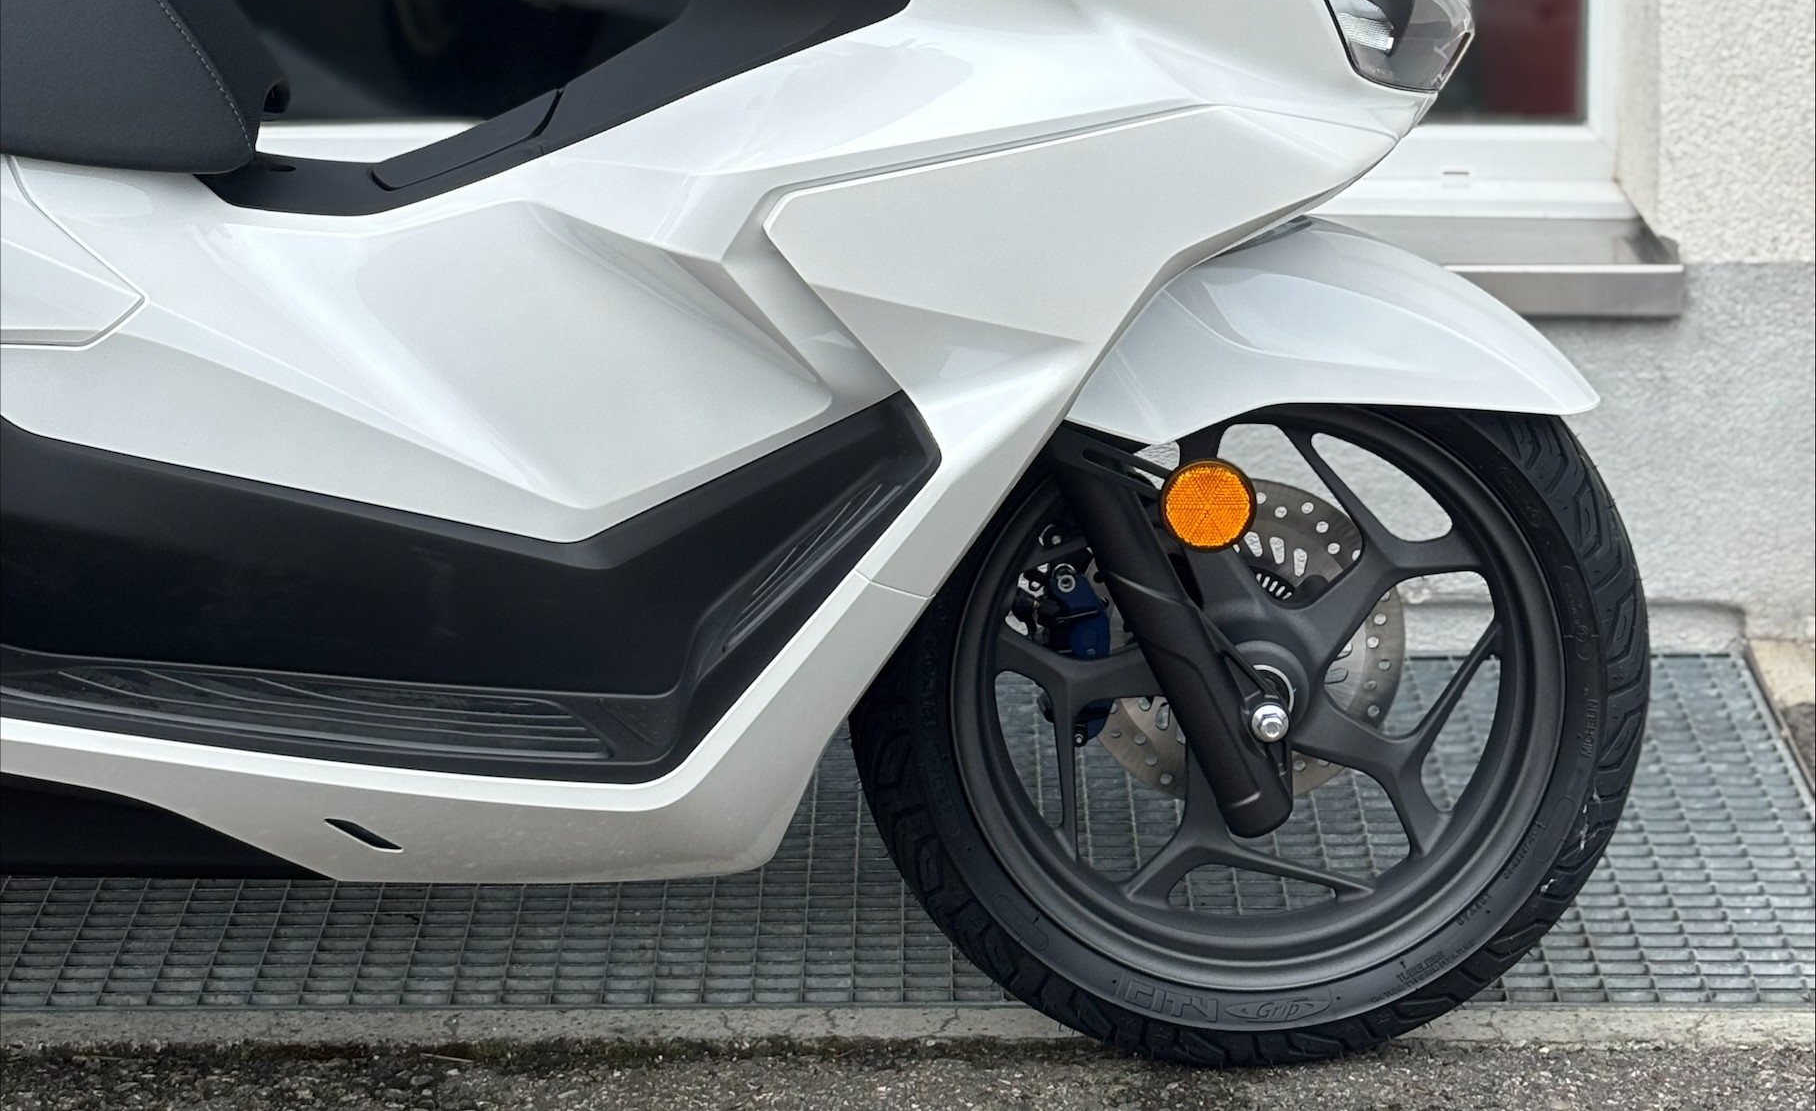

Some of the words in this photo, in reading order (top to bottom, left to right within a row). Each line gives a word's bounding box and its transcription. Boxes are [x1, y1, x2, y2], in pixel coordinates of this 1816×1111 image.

[1580, 699, 1599, 759] MICHELIN
[1396, 951, 1446, 982] TUBELESS
[1124, 977, 1219, 1023] CITY
[1256, 998, 1300, 1019] Grip
